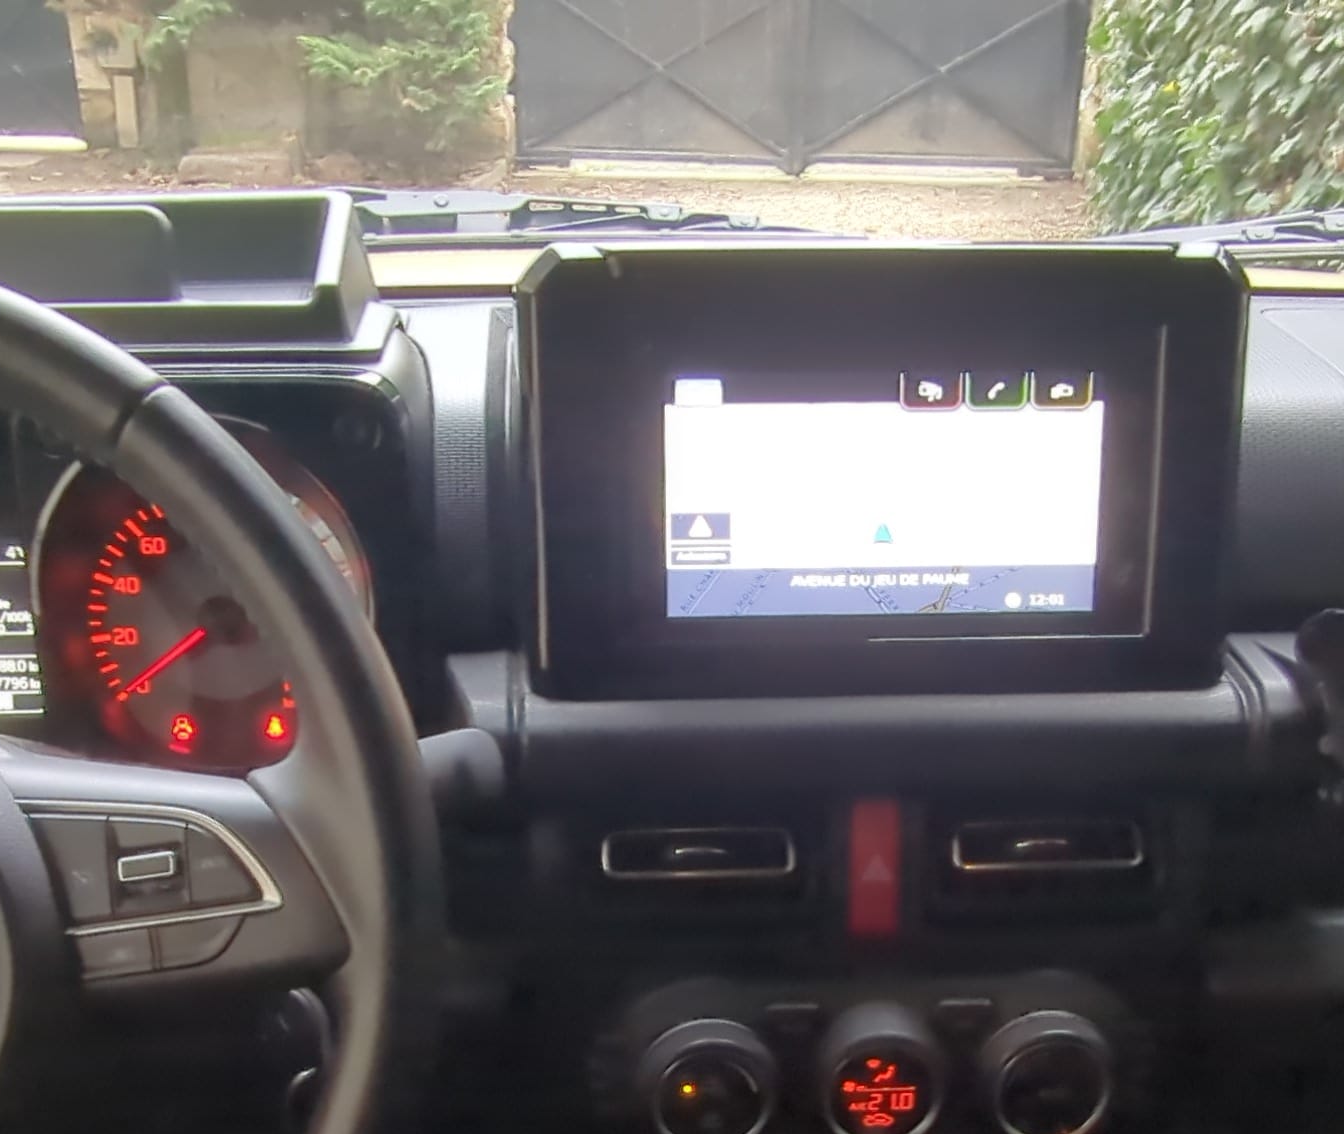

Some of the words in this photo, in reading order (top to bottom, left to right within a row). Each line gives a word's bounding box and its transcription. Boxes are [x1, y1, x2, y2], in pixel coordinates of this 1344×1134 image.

[141, 536, 166, 555] 60
[114, 576, 140, 594] 40
[789, 575, 846, 587] AVENUE
[849, 574, 870, 587] DU
[871, 574, 897, 588] JEU
[899, 574, 918, 587] DE
[112, 627, 138, 645] 20
